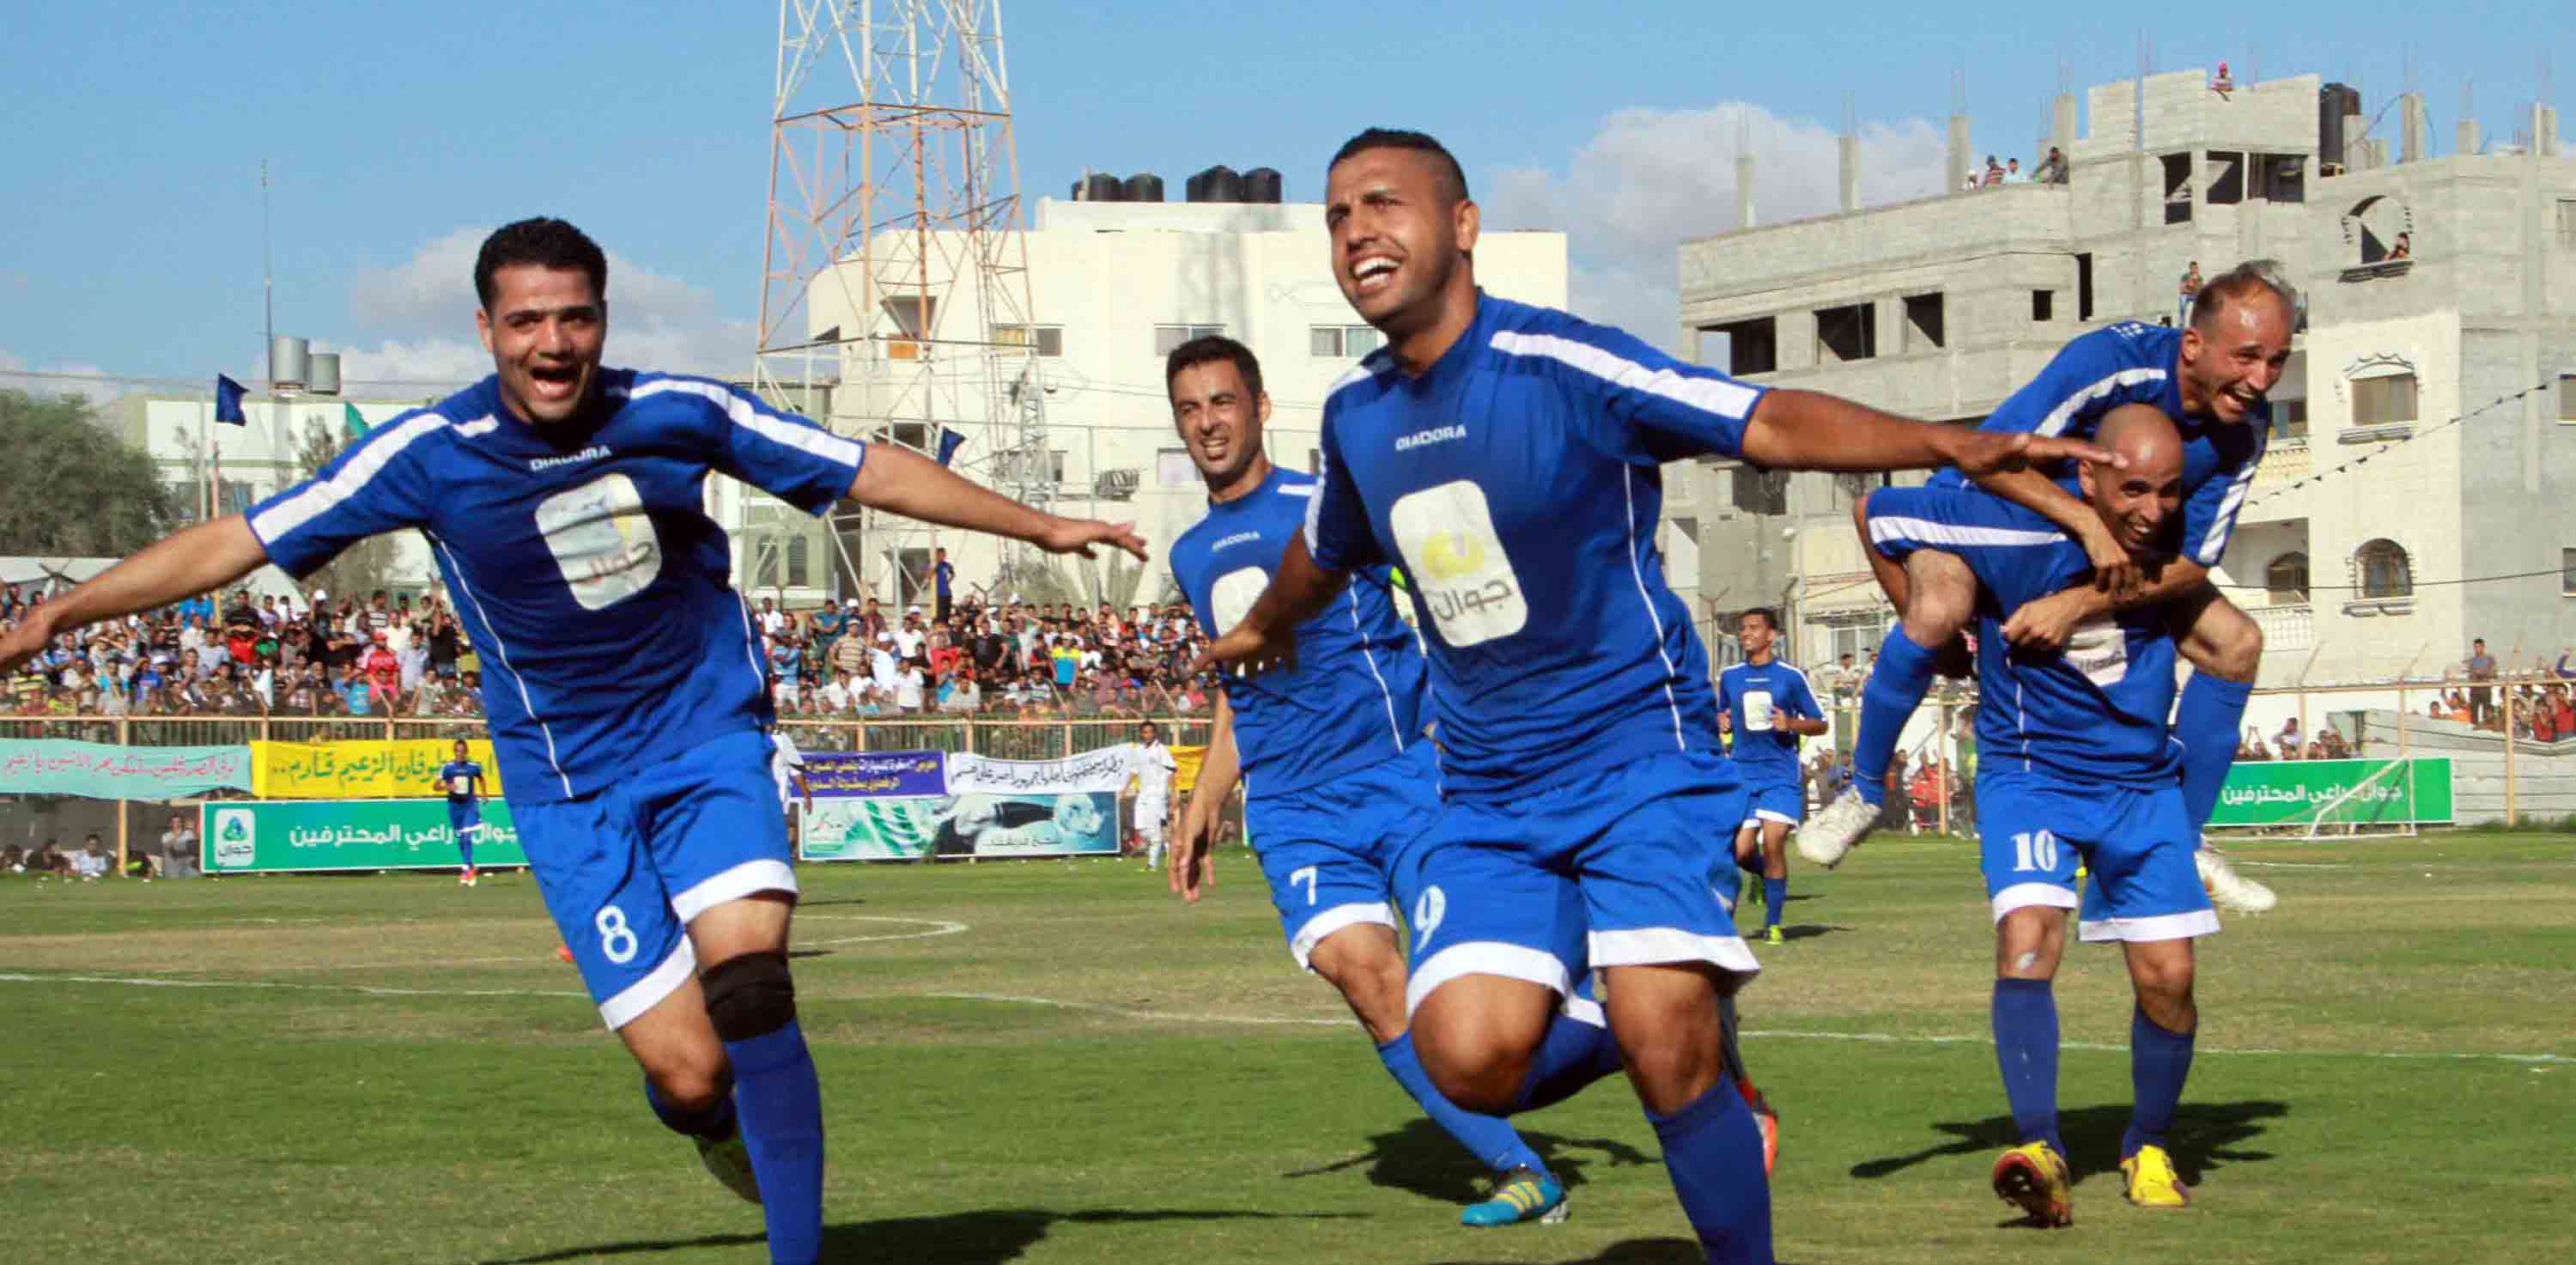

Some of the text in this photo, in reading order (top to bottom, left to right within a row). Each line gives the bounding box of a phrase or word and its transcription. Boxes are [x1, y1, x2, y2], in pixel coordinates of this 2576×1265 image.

[1395, 424, 1467, 451] DIADORA
[530, 445, 612, 471] DIADORA
[1434, 578, 1513, 622] جوال
[2221, 783, 2306, 806] المحترفين
[289, 823, 402, 848] المحترفين
[404, 823, 453, 850] راعي
[2010, 829, 2057, 873] 10
[1291, 866, 1317, 907] 7
[595, 904, 638, 964] 8
[1413, 884, 1447, 953] 9
